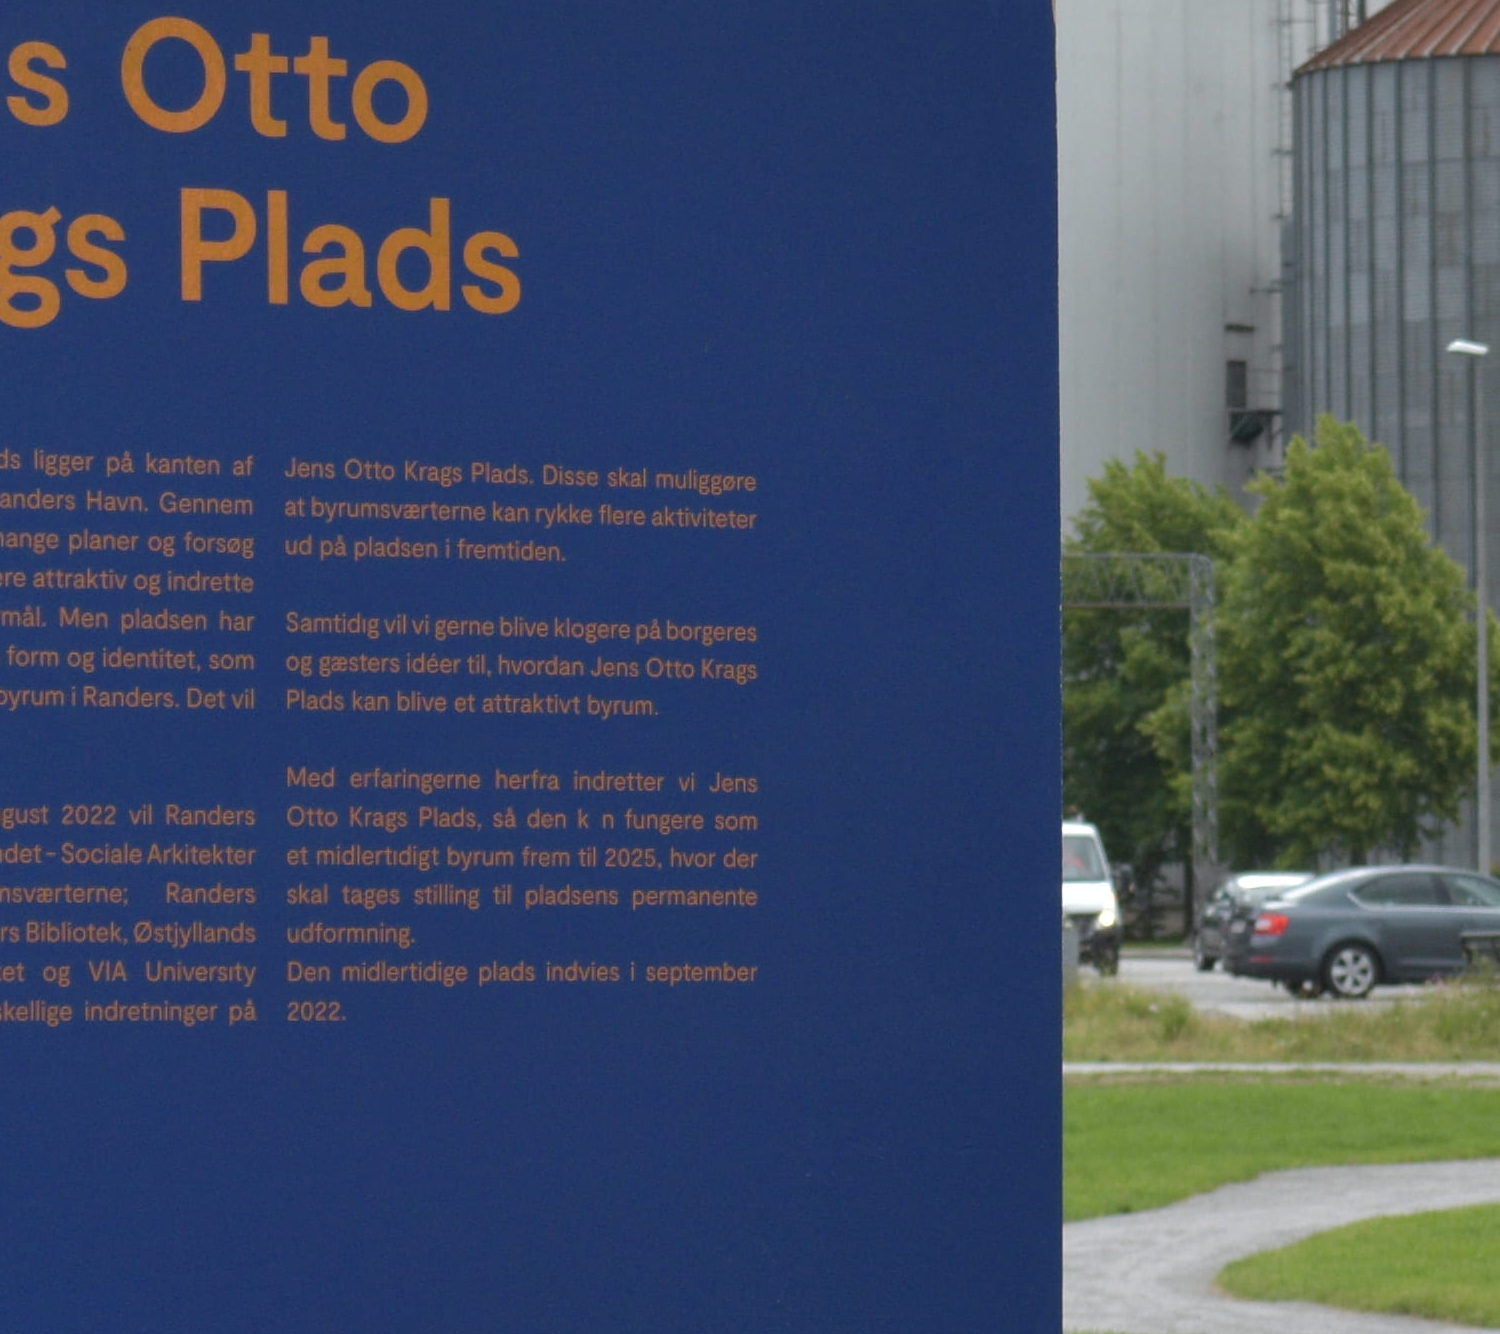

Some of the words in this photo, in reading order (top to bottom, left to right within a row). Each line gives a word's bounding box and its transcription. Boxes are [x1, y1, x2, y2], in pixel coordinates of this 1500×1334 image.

[120, 14, 429, 144] Otto
[180, 186, 522, 315] Plads
[34, 449, 94, 477] ligger
[106, 451, 135, 475] på
[146, 453, 222, 475] kanten
[233, 456, 254, 477] af
[285, 459, 336, 479] Jens
[344, 458, 396, 481] Otto
[404, 461, 464, 488] Krags
[471, 461, 533, 485] Plads.
[543, 464, 600, 487] Disse
[608, 467, 648, 488] skal
[655, 469, 757, 496] muliggøre
[86, 491, 147, 512] Havn.
[159, 491, 254, 515] Gennem
[285, 499, 306, 517] at
[311, 497, 487, 522] byrumsværterne
[492, 502, 530, 523] kan
[535, 504, 594, 528] rykke
[599, 504, 647, 526] flere
[652, 507, 757, 529] aktiviteter
[68, 529, 139, 553] planer
[148, 535, 176, 557] og
[184, 531, 255, 560] forsøg
[285, 536, 314, 556] ud
[320, 535, 348, 560] på
[354, 537, 439, 561] pladsen
[457, 539, 564, 561] fremtiden.
[33, 569, 128, 589] attraktiv
[134, 574, 162, 597] og
[168, 571, 255, 593] indrette
[59, 607, 110, 629] Men
[121, 609, 208, 633] pladsen
[220, 611, 255, 632] har
[7, 645, 60, 667] form
[67, 651, 96, 673] og
[209, 653, 256, 670] som
[286, 655, 314, 677] og
[319, 654, 401, 677] gæsters
[406, 653, 462, 674] idéer
[498, 655, 585, 677] hvordan
[591, 657, 640, 677] Jens
[646, 656, 696, 679] Otto
[701, 659, 758, 685] Krags
[286, 688, 345, 711] Plads
[352, 691, 391, 711] kan
[397, 691, 448, 712] blive
[454, 694, 476, 713] et
[482, 694, 581, 714] attraktivt
[587, 695, 657, 720] byrum.
[287, 767, 336, 788] Med
[350, 768, 482, 795] erfaringerne
[495, 769, 561, 791] herfra
[574, 771, 664, 792] indretter
[679, 774, 696, 791] vi
[710, 773, 759, 793] Jens
[62, 804, 117, 825] 2022
[130, 804, 154, 824] vil
[166, 803, 257, 826] Randers
[287, 847, 308, 866] et
[447, 846, 515, 871] byrum
[522, 846, 572, 867] frem
[578, 847, 598, 867] til
[605, 847, 662, 869] 2025,
[670, 848, 716, 868] hvor
[723, 848, 758, 869] der
[166, 881, 257, 904] Randers
[287, 883, 329, 905] skal
[342, 886, 401, 910] tages
[414, 883, 480, 910] stilling
[493, 884, 513, 904] til
[525, 885, 620, 909] pladsens
[632, 888, 759, 909] permanente
[26, 920, 128, 944] Bibliotek,
[134, 920, 257, 948] Østjyllands
[287, 922, 415, 949] udformning.
[42, 965, 71, 988] og
[89, 960, 128, 981] VIA
[84, 1000, 218, 1027] indretninger
[229, 999, 257, 1024] på
[288, 1000, 345, 1022] 2022.
